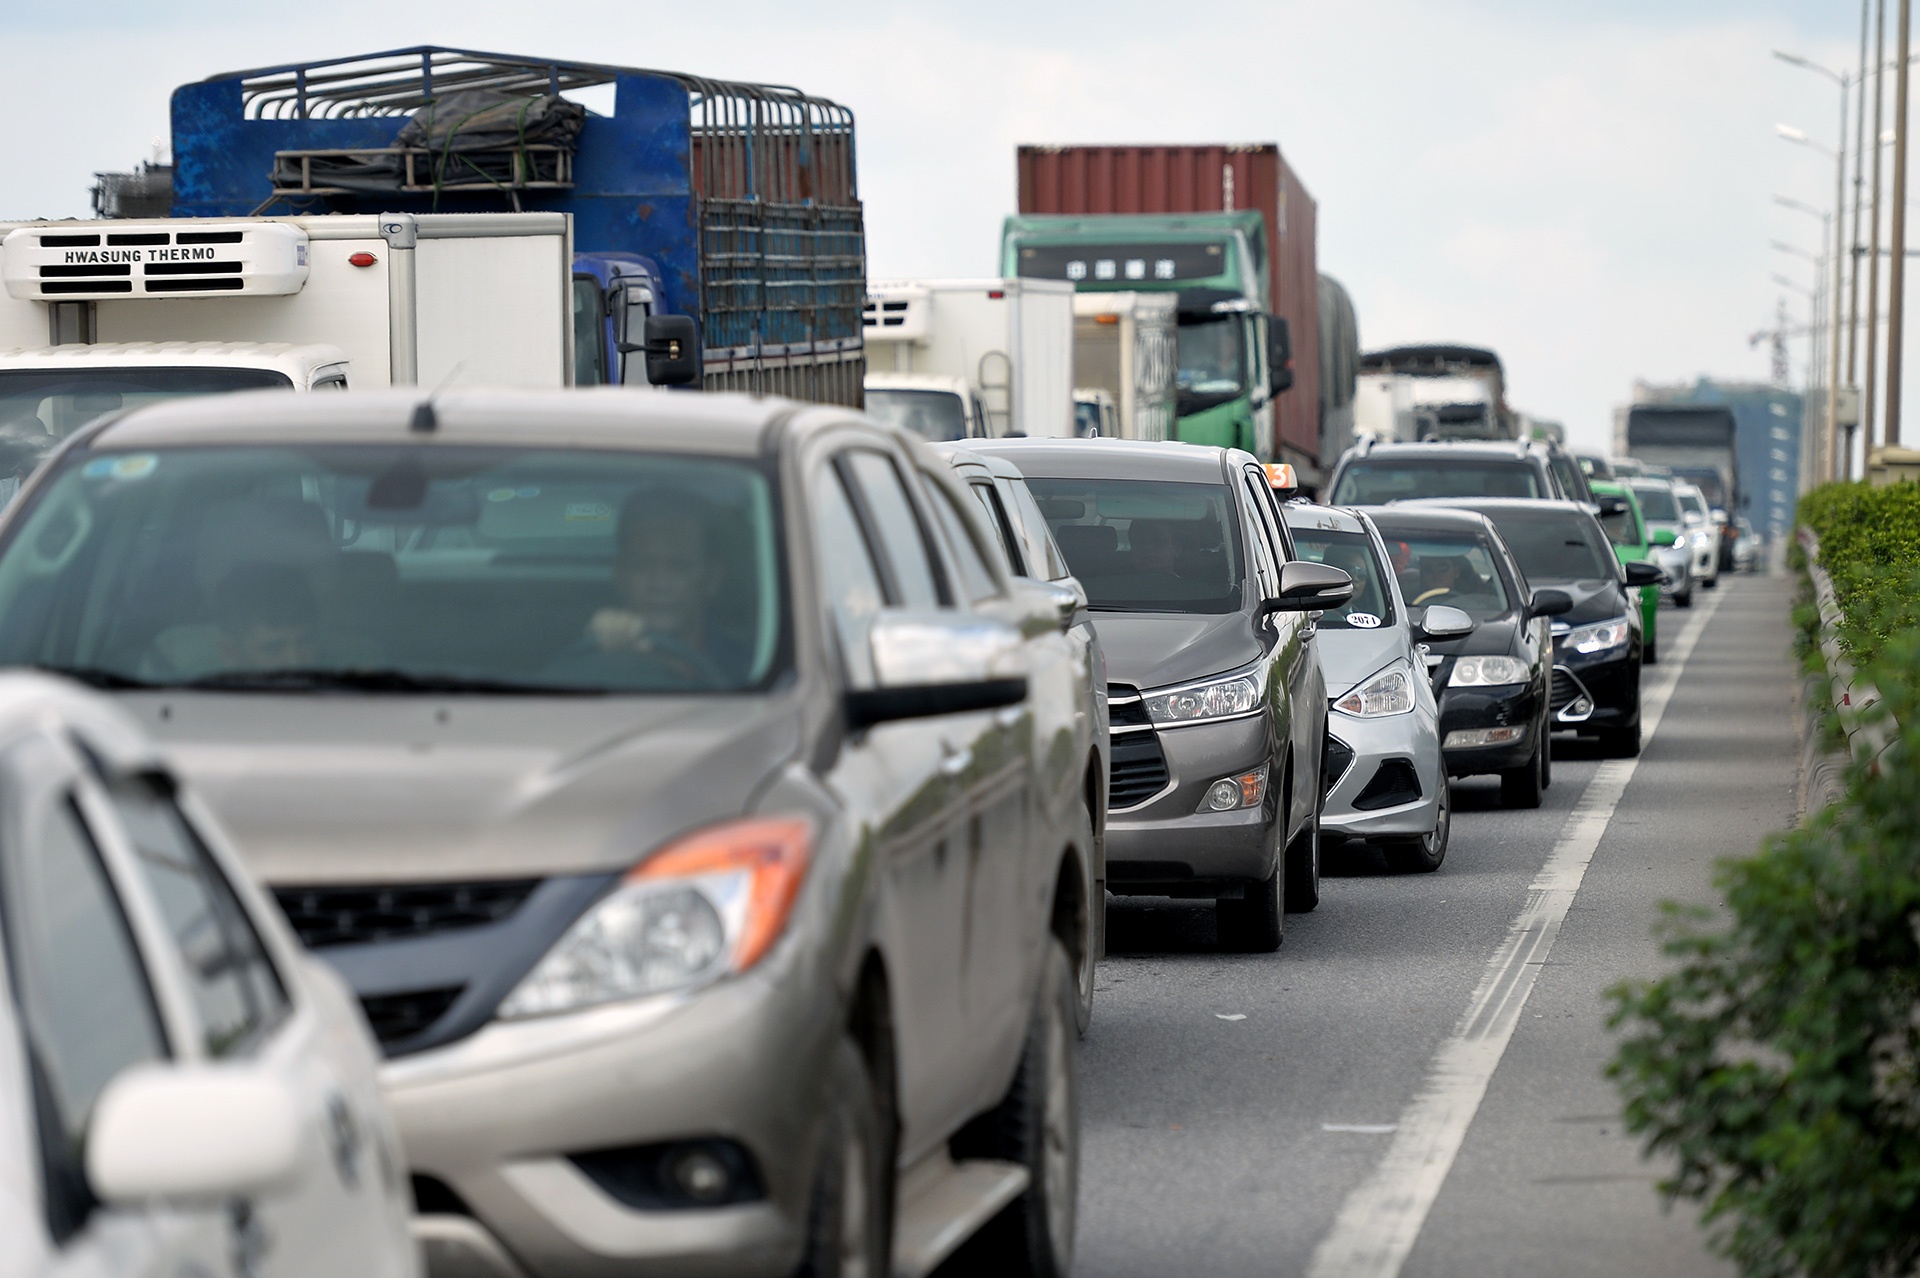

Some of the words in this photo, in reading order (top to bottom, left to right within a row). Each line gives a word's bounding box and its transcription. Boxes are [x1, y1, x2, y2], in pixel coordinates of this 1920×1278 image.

[65, 250, 141, 263] HWASUNG
[148, 247, 215, 261] THERMO
[1261, 464, 1287, 488] 3
